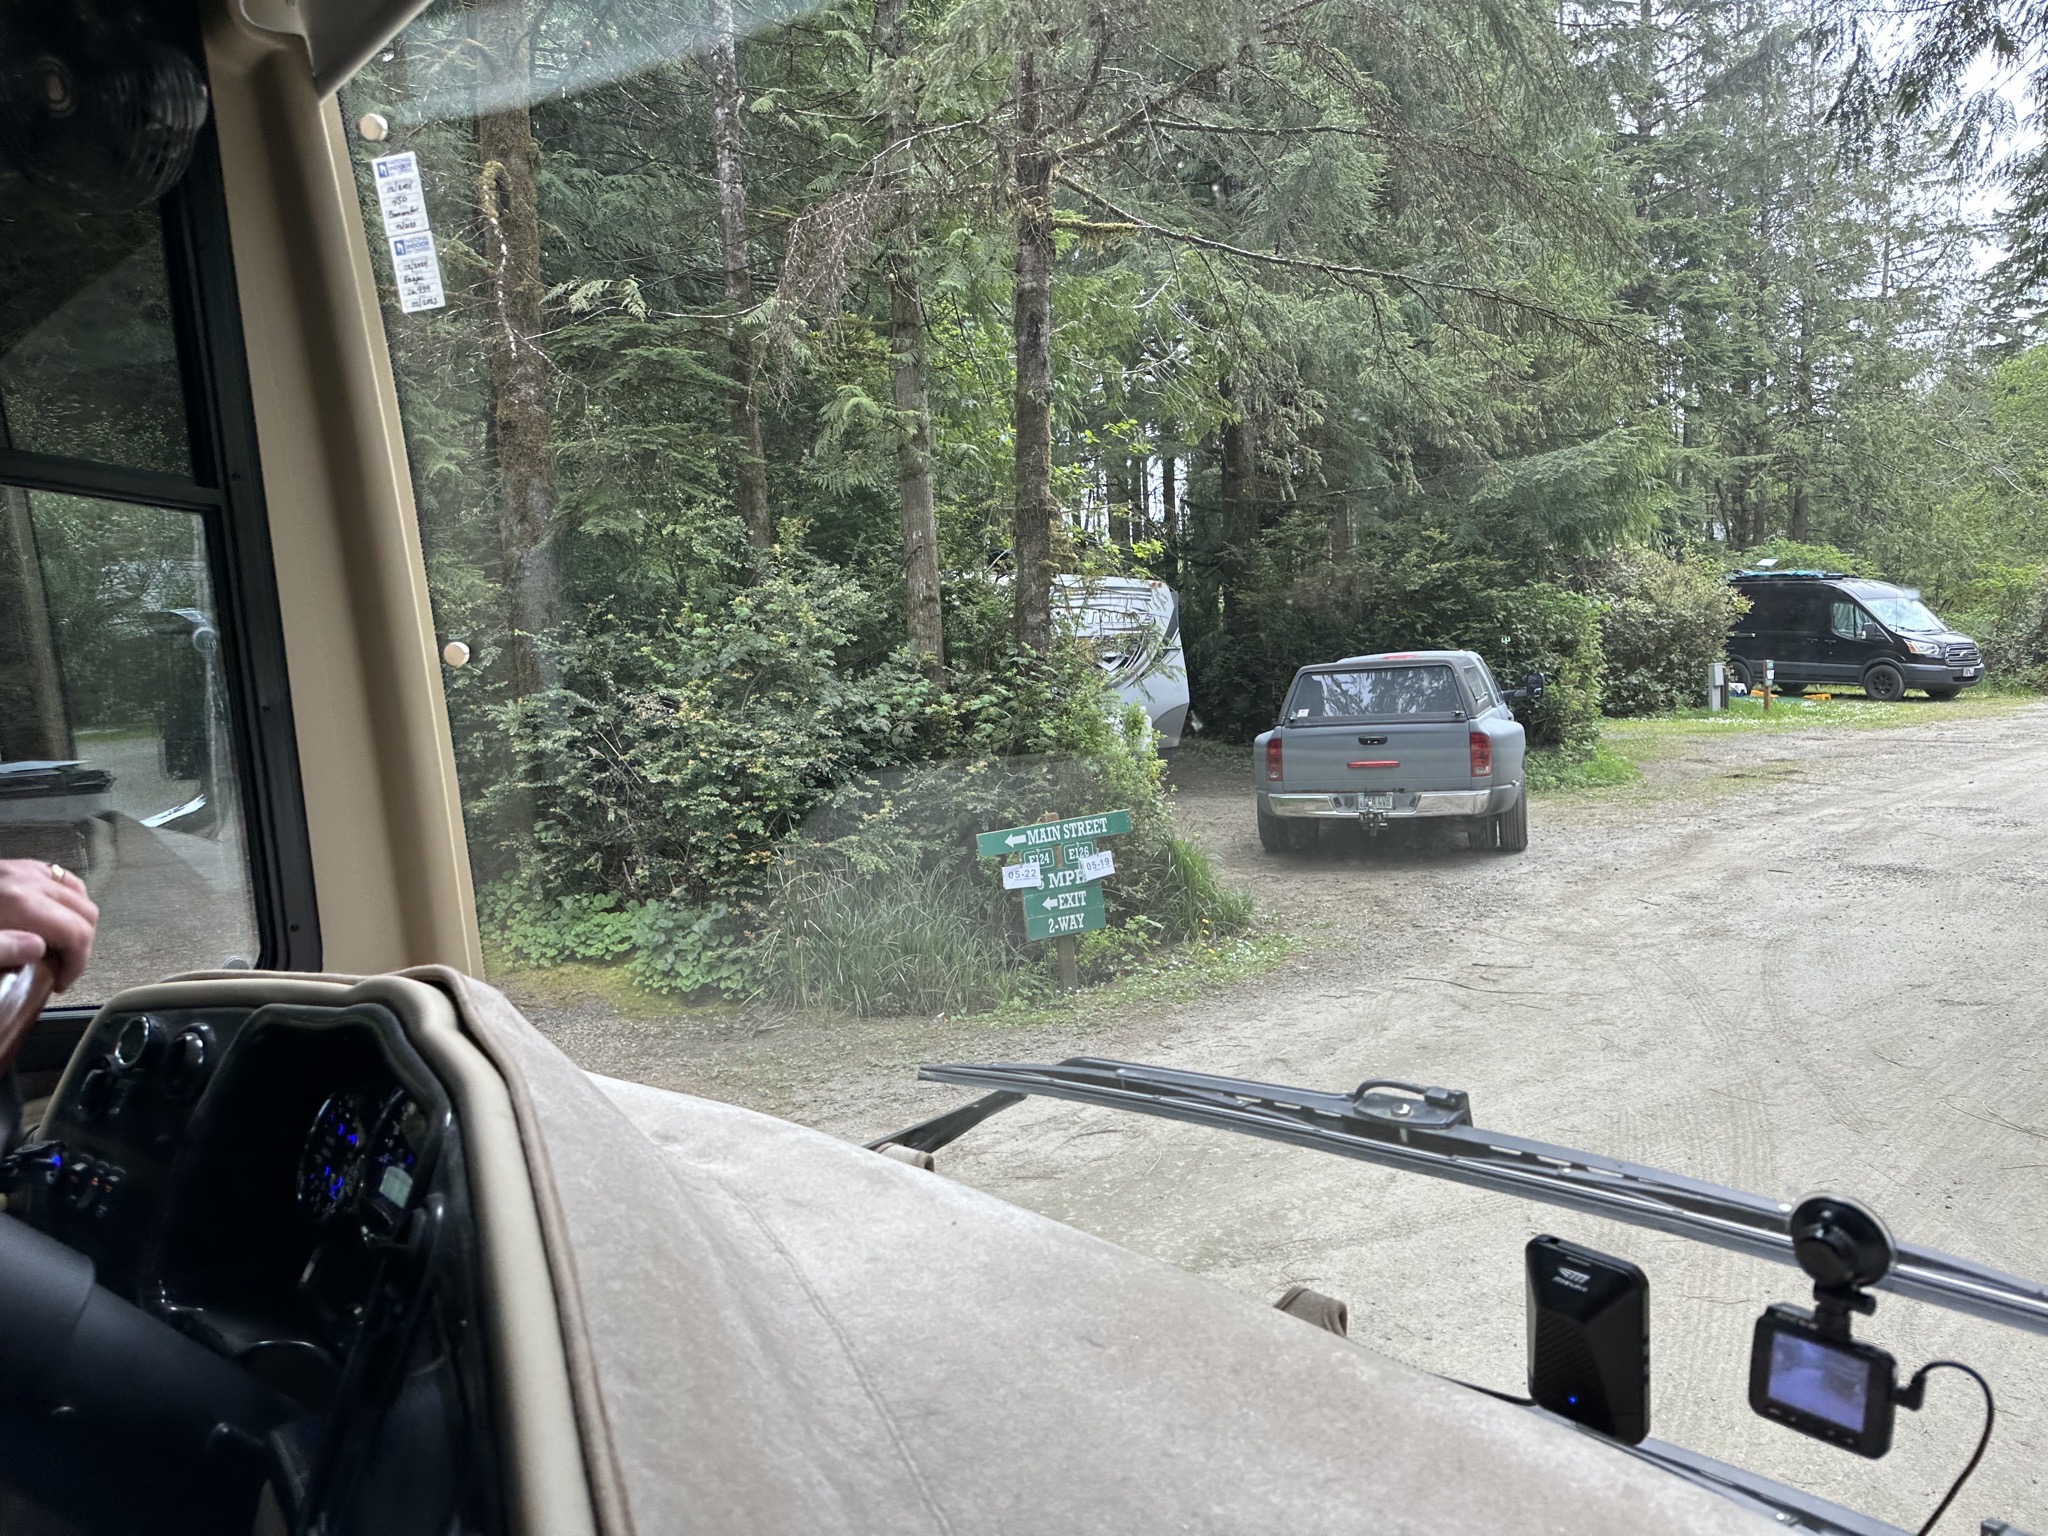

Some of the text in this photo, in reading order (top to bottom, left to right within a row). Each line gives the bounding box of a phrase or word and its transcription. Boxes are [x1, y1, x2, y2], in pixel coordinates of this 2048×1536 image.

[1026, 817, 1108, 846] MAIN STREET
[1068, 846, 1089, 860] E126
[1086, 857, 1110, 872] 05-19
[1008, 868, 1037, 880] 05-22
[1058, 890, 1087, 910] EXIT
[1048, 913, 1085, 934] 2-WAY
